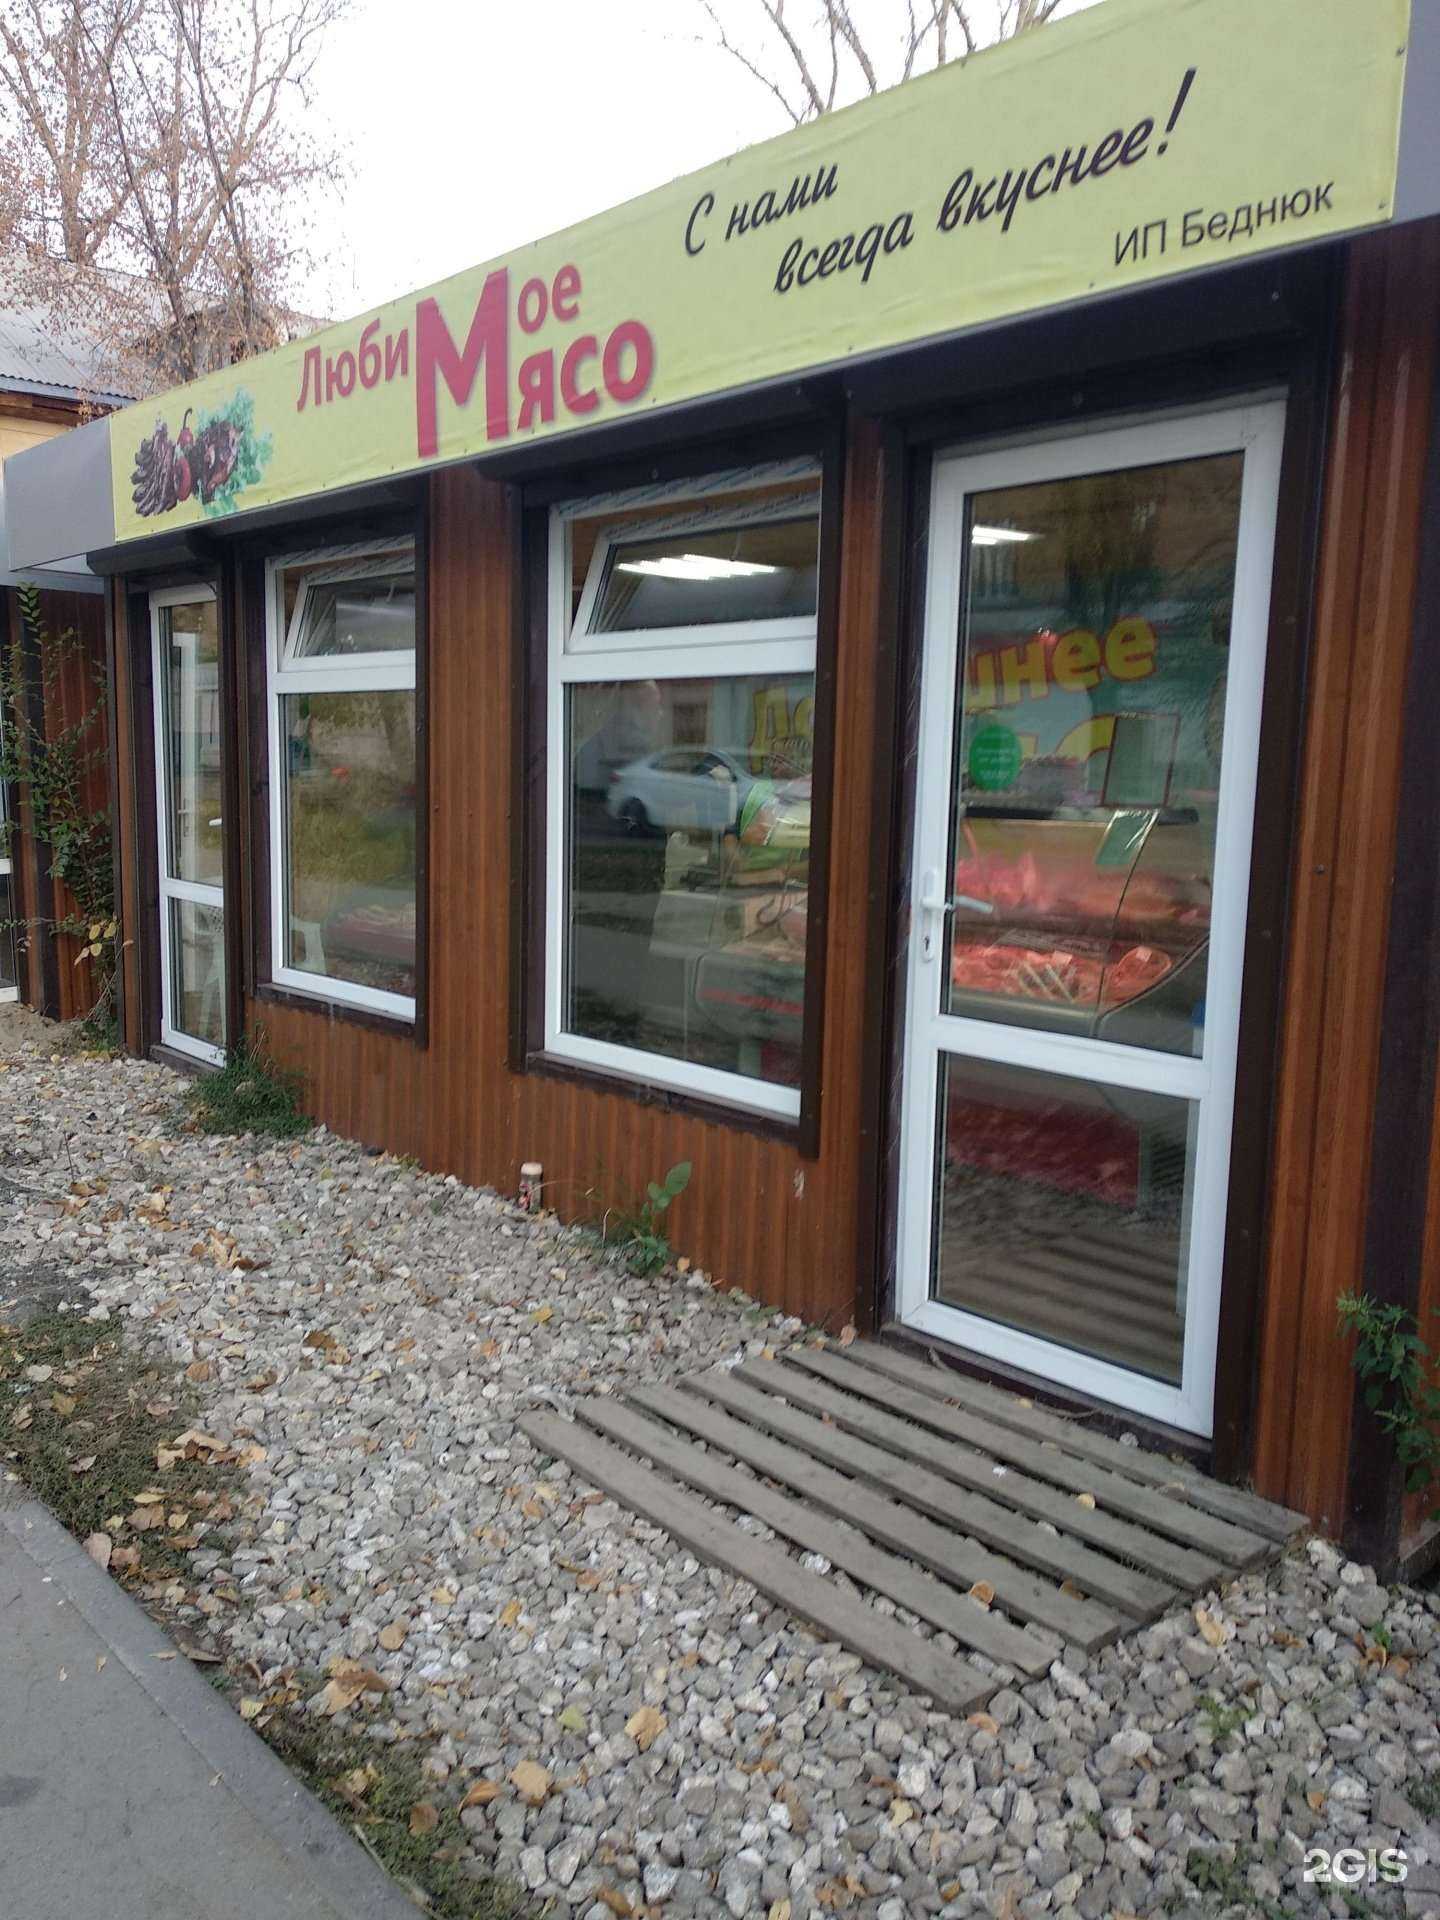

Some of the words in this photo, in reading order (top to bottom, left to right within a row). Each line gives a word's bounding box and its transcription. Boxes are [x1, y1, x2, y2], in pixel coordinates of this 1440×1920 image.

[684, 192, 715, 257] С
[724, 164, 839, 242] нами
[773, 212, 915, 295] всегда
[935, 67, 1197, 234] вкуснее!
[1114, 218, 1167, 267] ИП
[1181, 181, 1335, 248] Беднюк
